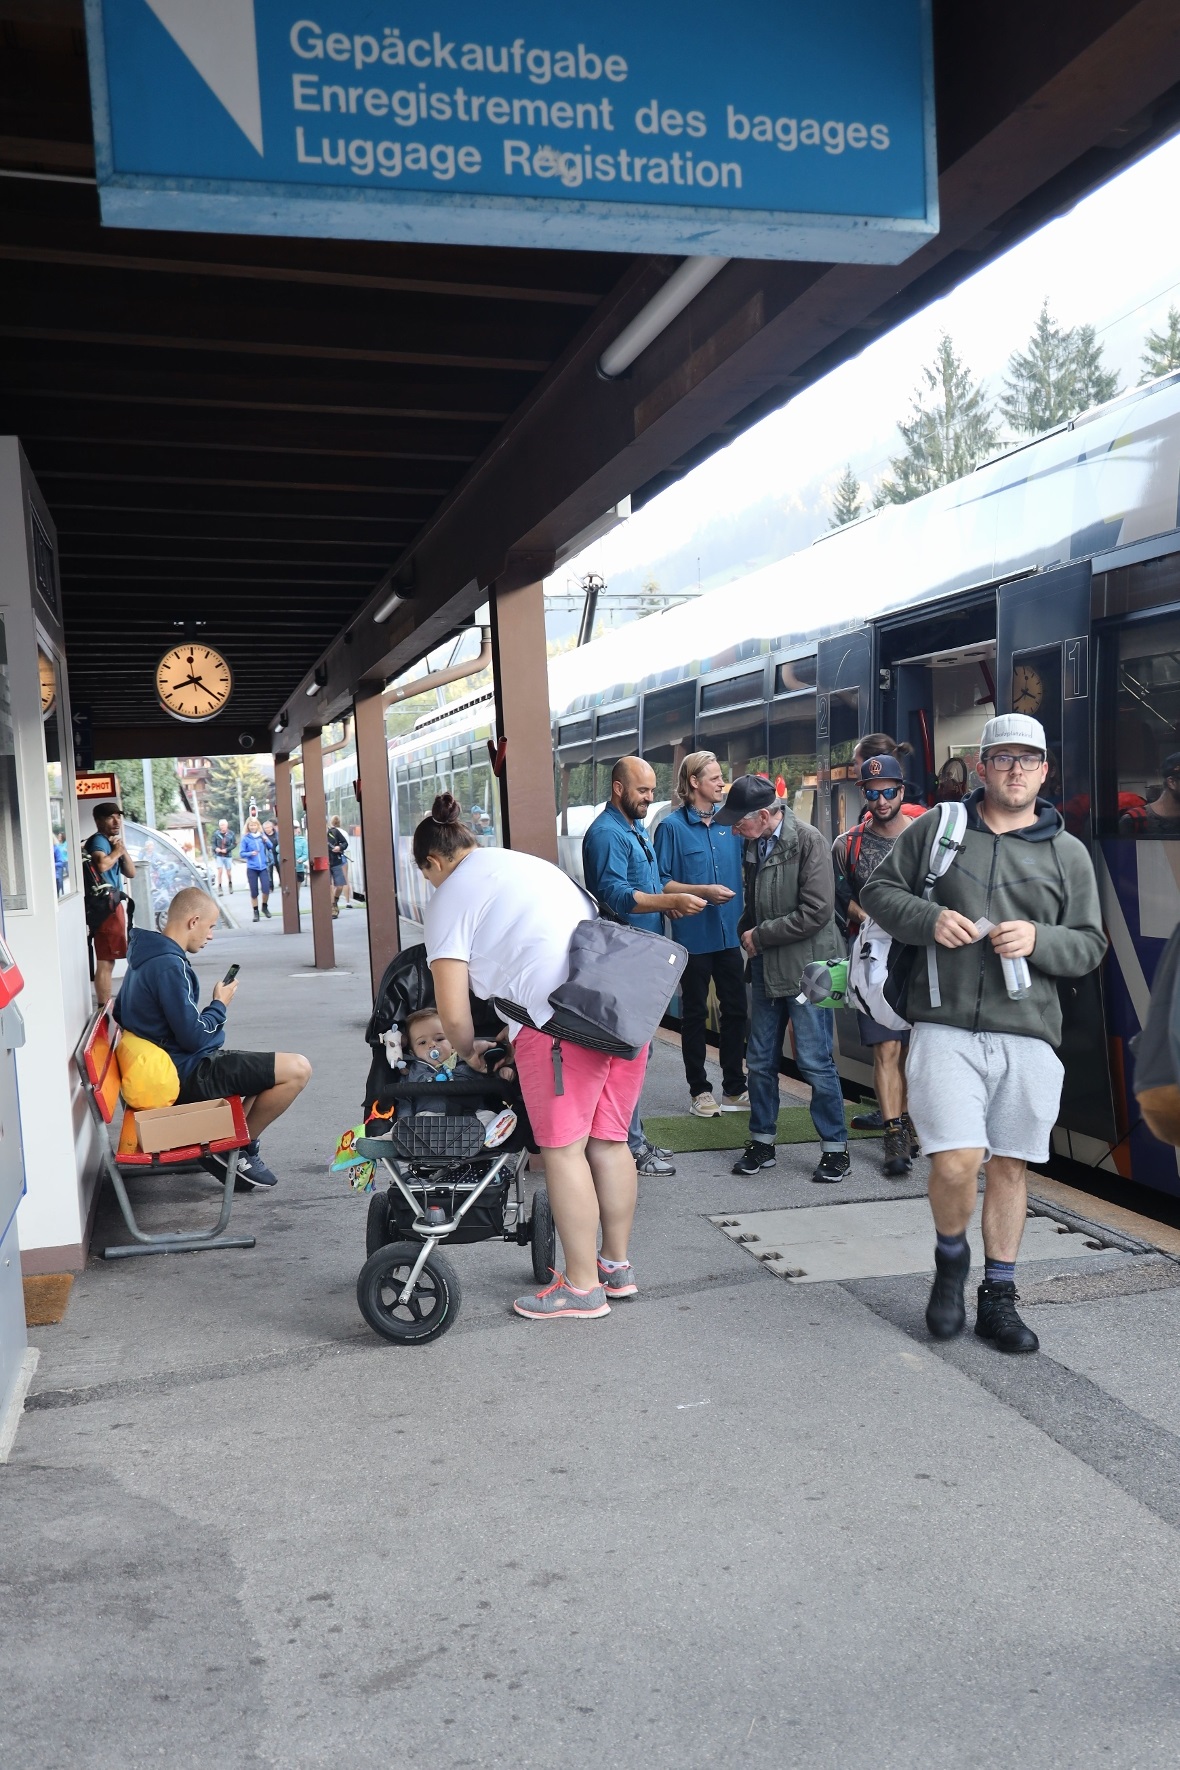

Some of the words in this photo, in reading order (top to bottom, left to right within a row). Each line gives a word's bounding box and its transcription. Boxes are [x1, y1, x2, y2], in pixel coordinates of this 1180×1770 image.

[290, 20, 628, 84] Gepäckaufgabe
[292, 73, 614, 131] Enregistrement
[635, 99, 707, 137] des
[727, 105, 890, 155] bagages
[296, 126, 482, 181] Luggage
[503, 139, 742, 189] Registration
[1068, 641, 1080, 695] 1
[818, 696, 828, 735] 2
